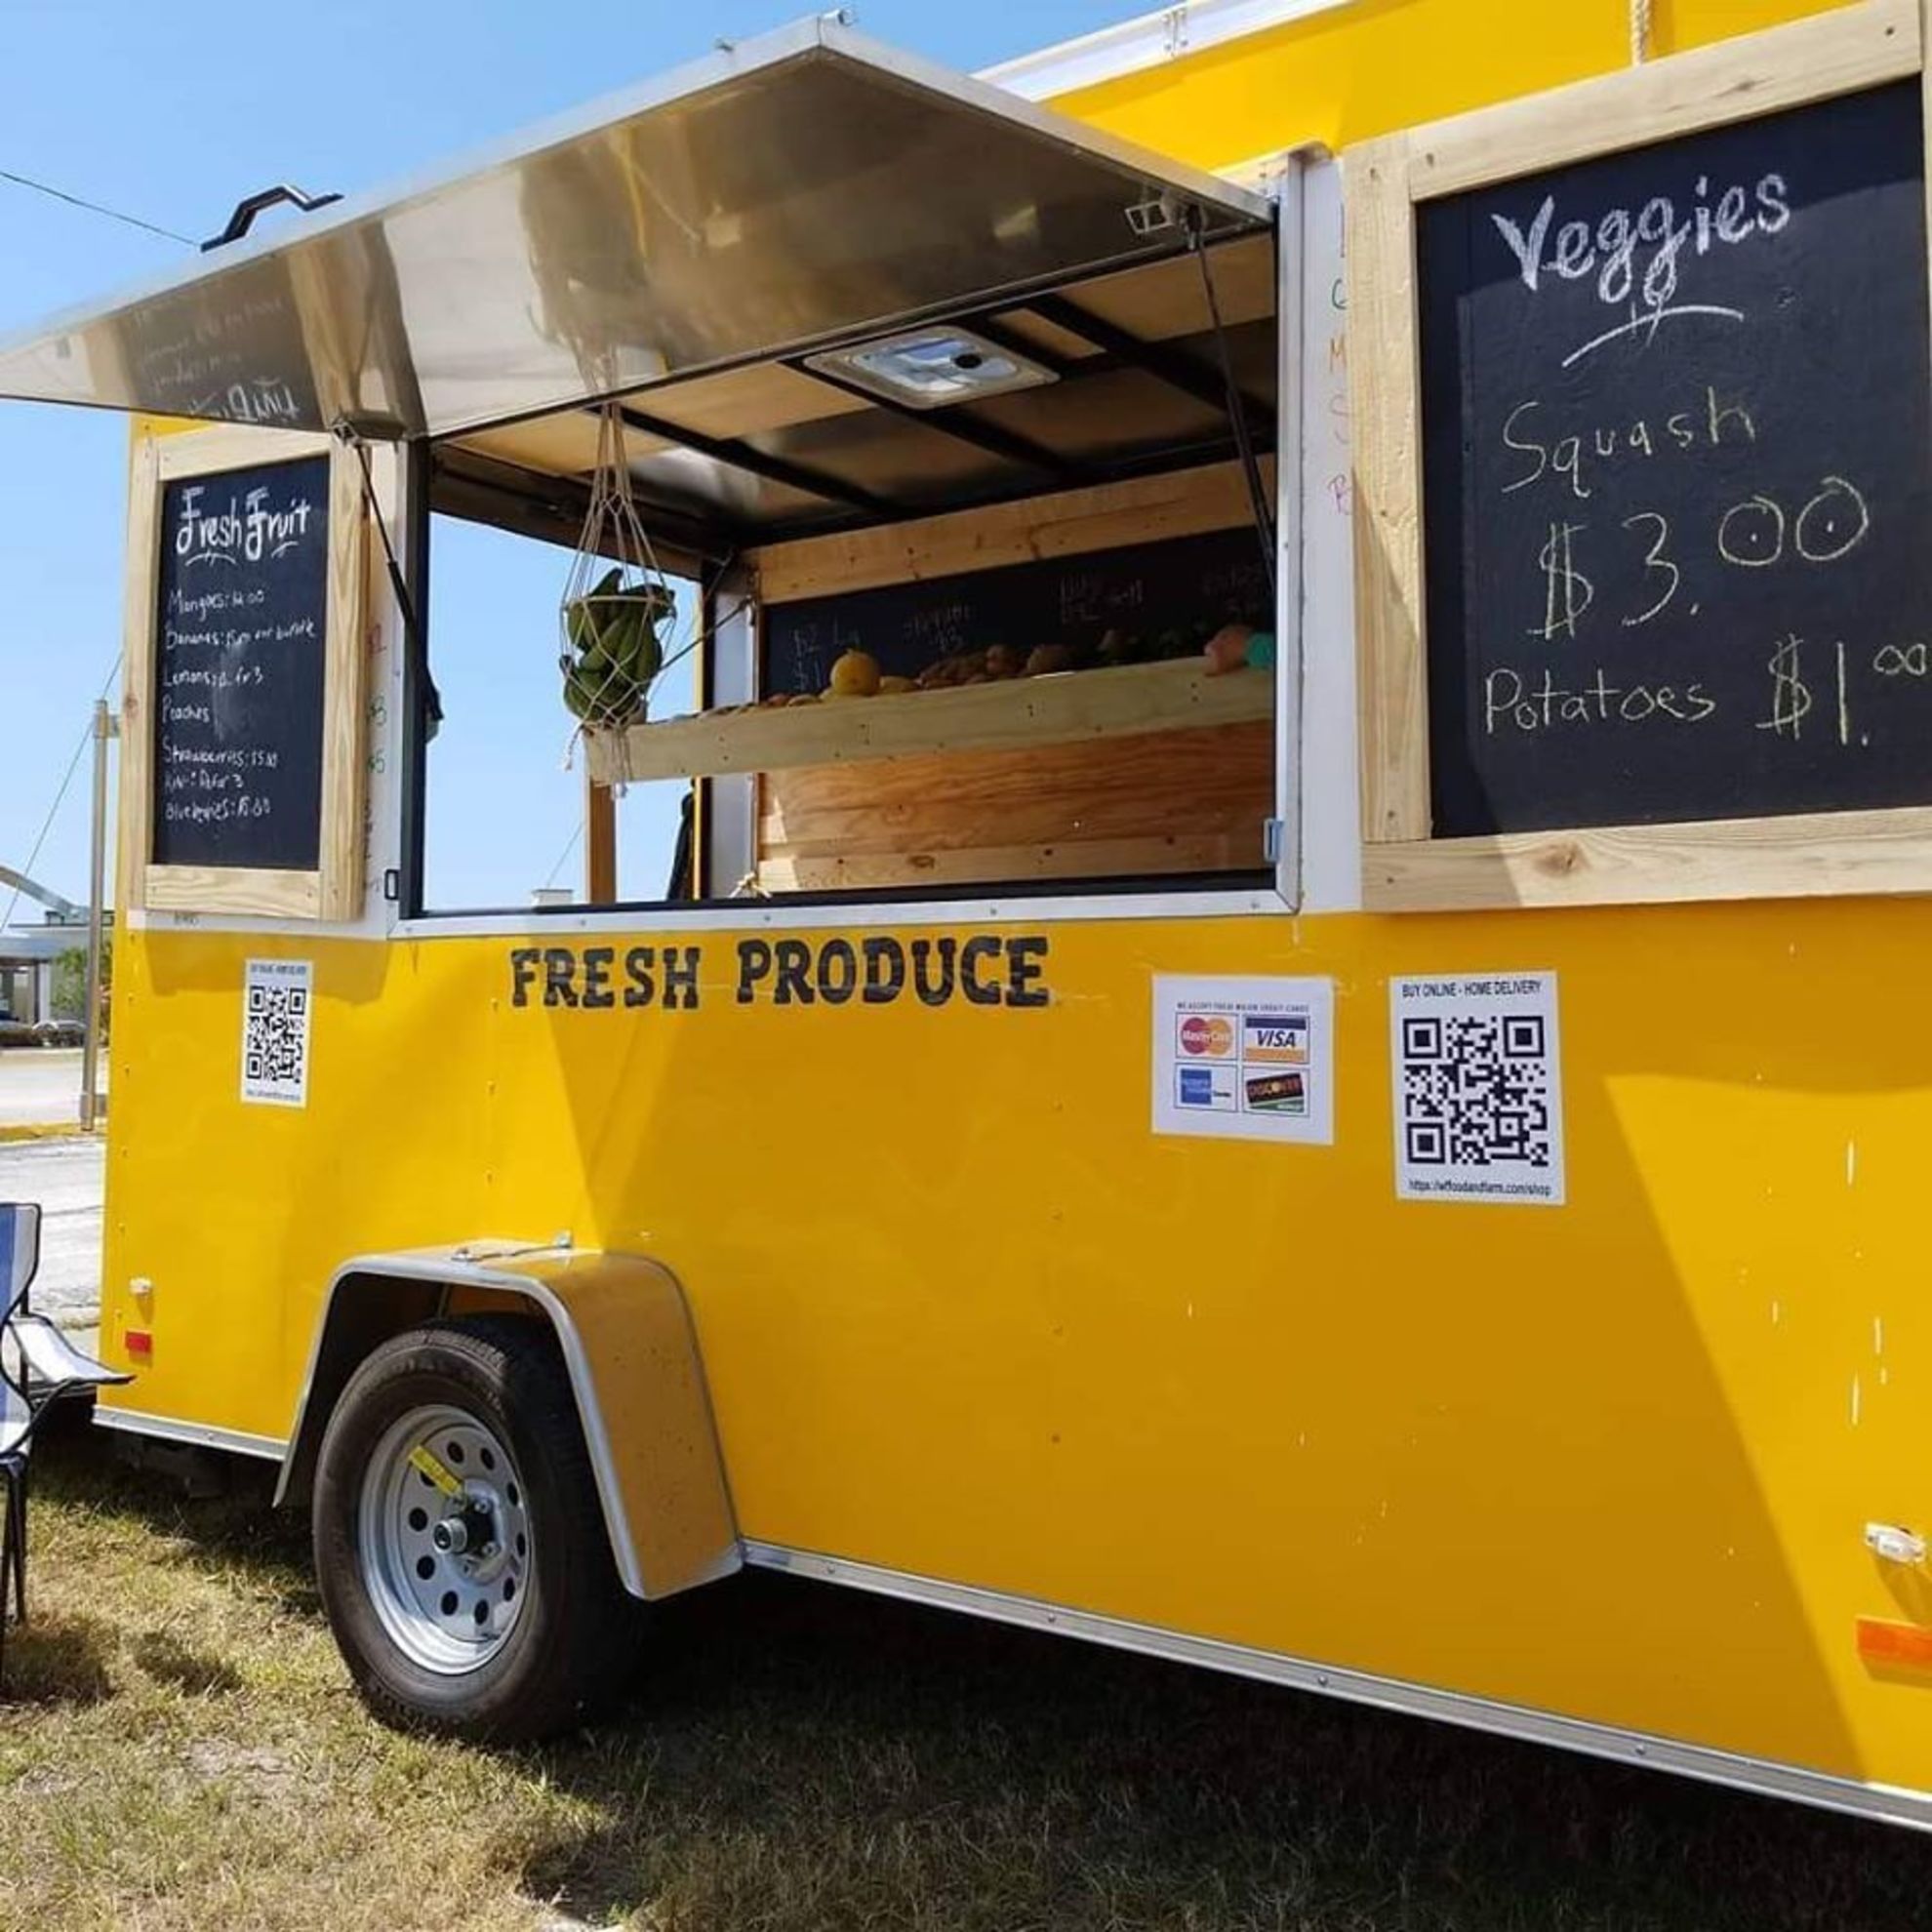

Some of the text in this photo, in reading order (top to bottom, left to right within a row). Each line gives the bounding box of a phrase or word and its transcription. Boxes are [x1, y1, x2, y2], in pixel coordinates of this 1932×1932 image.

[1491, 173, 1792, 306] Veggies
[1501, 386, 1756, 499] Squash
[176, 486, 310, 562] Fresh Fruit
[1484, 668, 1715, 734] Potatoes
[509, 936, 1050, 1009] FRESH PRODUCE
[1402, 984, 1420, 997] BUY
[1424, 983, 1457, 997] ONLINE
[1465, 982, 1492, 995] HOME
[1495, 980, 1542, 995] DELIVERY
[1257, 1030, 1296, 1047] VISA
